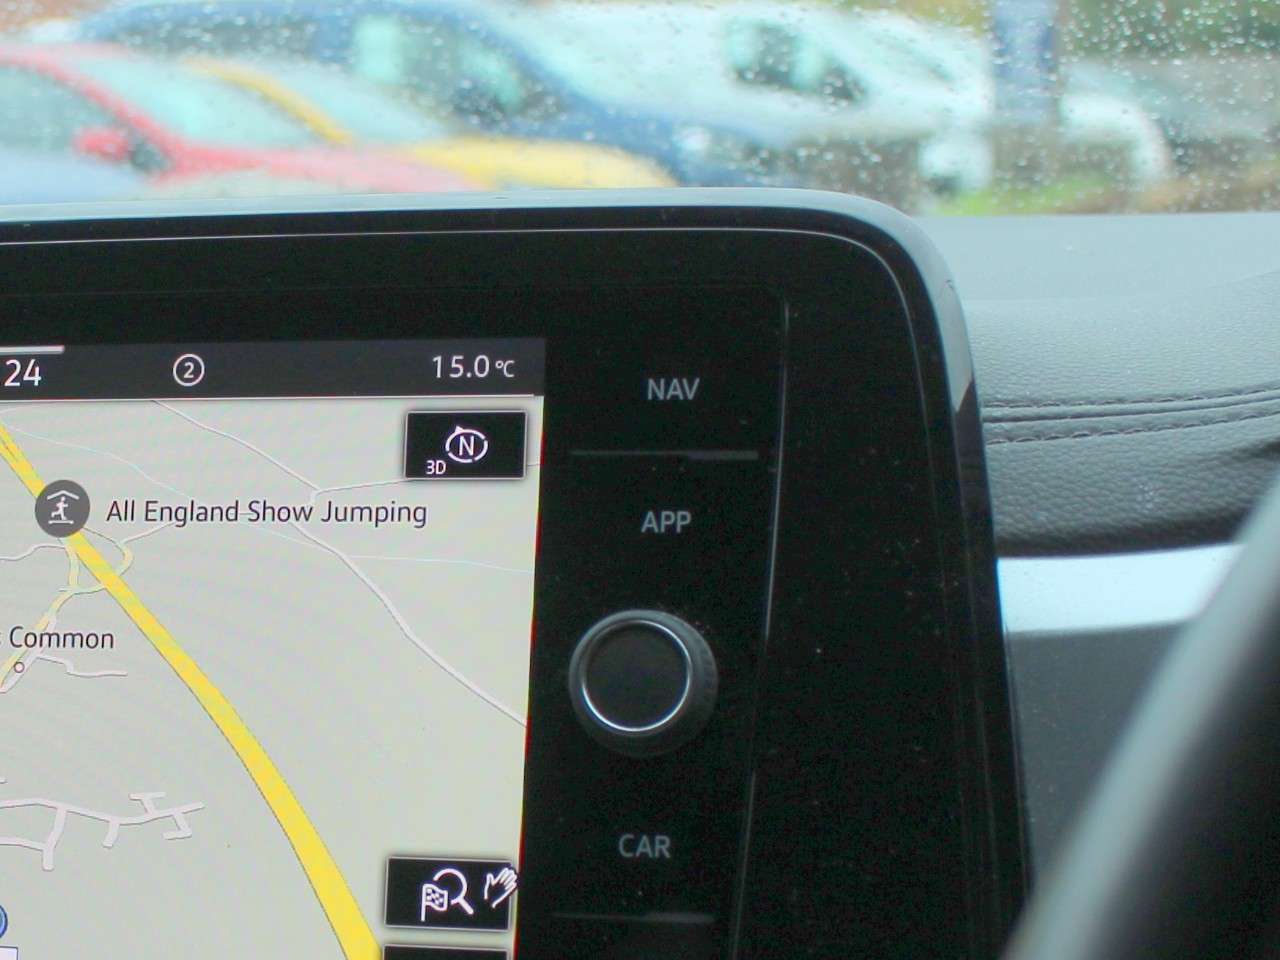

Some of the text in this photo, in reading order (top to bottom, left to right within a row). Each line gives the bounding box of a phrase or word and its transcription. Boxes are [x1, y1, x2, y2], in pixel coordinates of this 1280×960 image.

[182, 359, 196, 380] 2
[646, 377, 700, 401] NAV
[458, 434, 476, 457] N
[425, 459, 447, 476] 3D
[106, 499, 428, 528] All England Show Jumping
[640, 510, 693, 534] APP
[8, 625, 116, 650] Common
[618, 833, 671, 859] CAR
